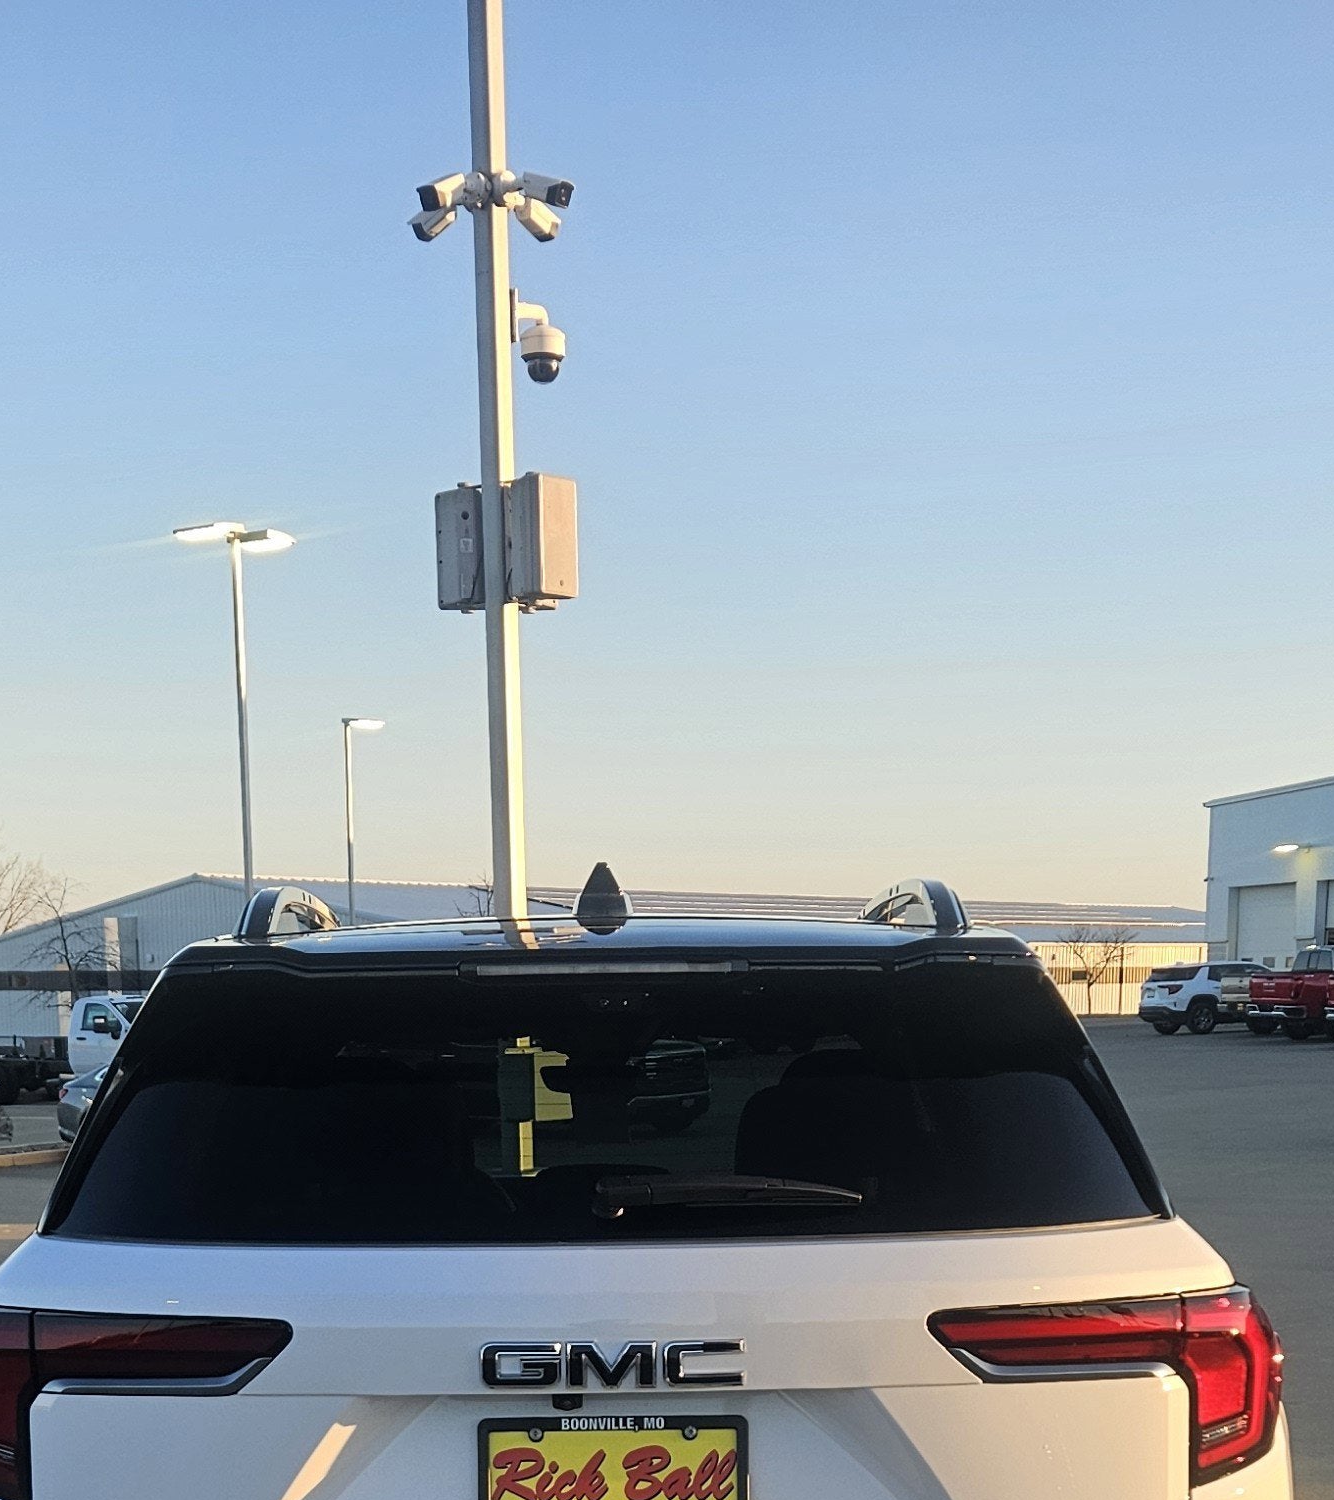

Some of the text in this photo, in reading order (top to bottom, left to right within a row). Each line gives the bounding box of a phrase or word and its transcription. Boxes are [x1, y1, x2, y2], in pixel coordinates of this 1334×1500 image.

[480, 1338, 748, 1389] GMC
[561, 1417, 665, 1432] BOONVILLE, MO
